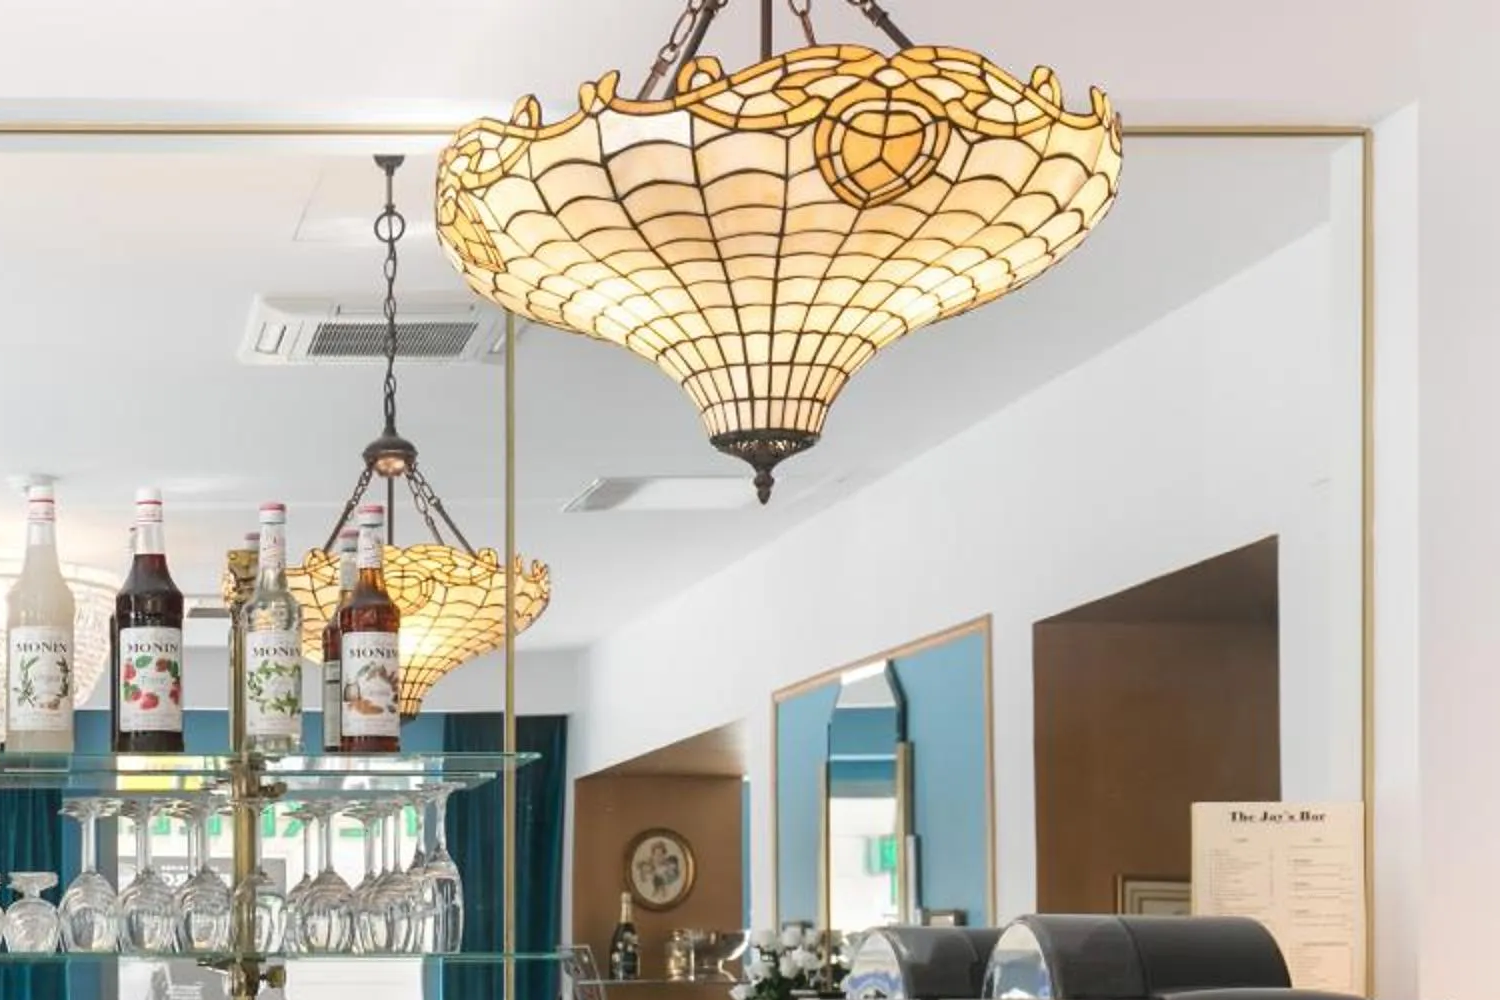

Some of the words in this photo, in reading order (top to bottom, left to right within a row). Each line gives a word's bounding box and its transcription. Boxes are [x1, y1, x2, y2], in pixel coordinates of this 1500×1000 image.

[16, 641, 68, 653] MONIN
[127, 643, 179, 653] MONIN
[1229, 810, 1255, 822] The
[1299, 810, 1326, 822] Bar
